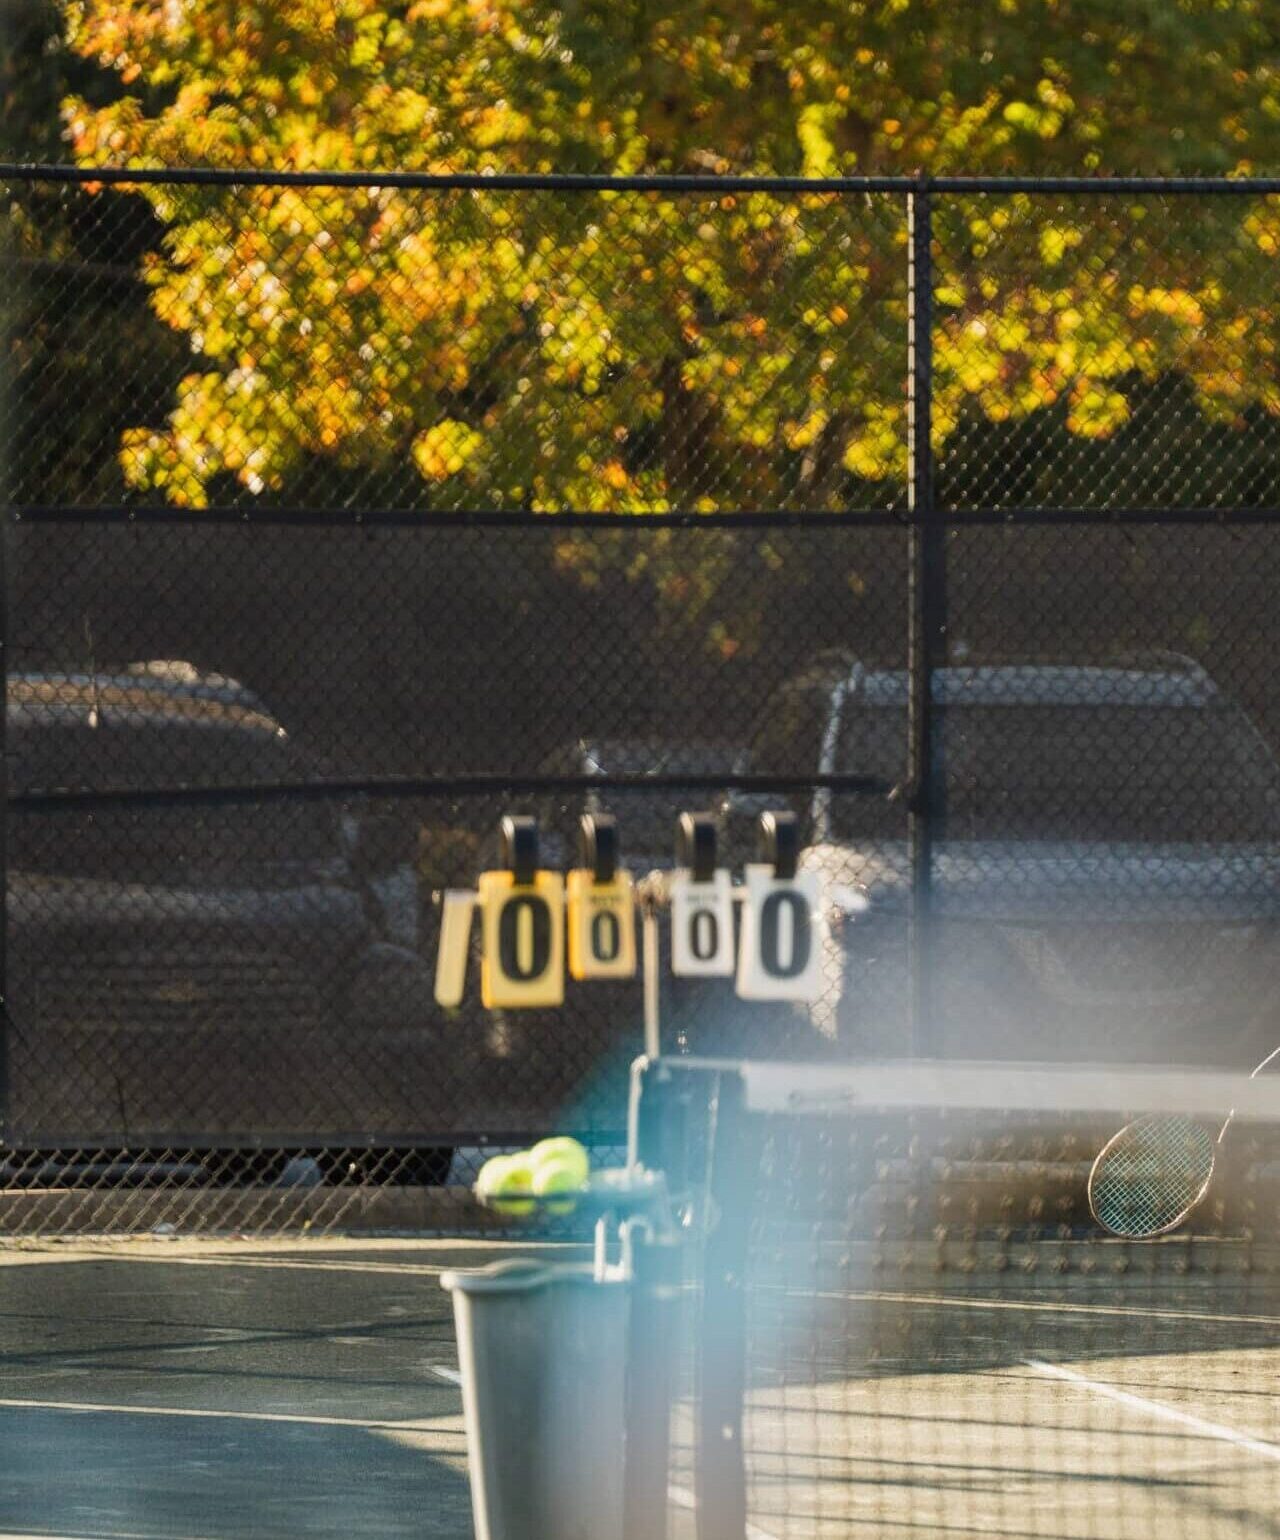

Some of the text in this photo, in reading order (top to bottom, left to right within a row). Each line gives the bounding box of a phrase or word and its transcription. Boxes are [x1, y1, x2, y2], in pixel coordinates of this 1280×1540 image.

[501, 893, 552, 982] 0
[592, 910, 620, 961] 0
[690, 909, 719, 961] 0
[759, 888, 812, 979] 0
